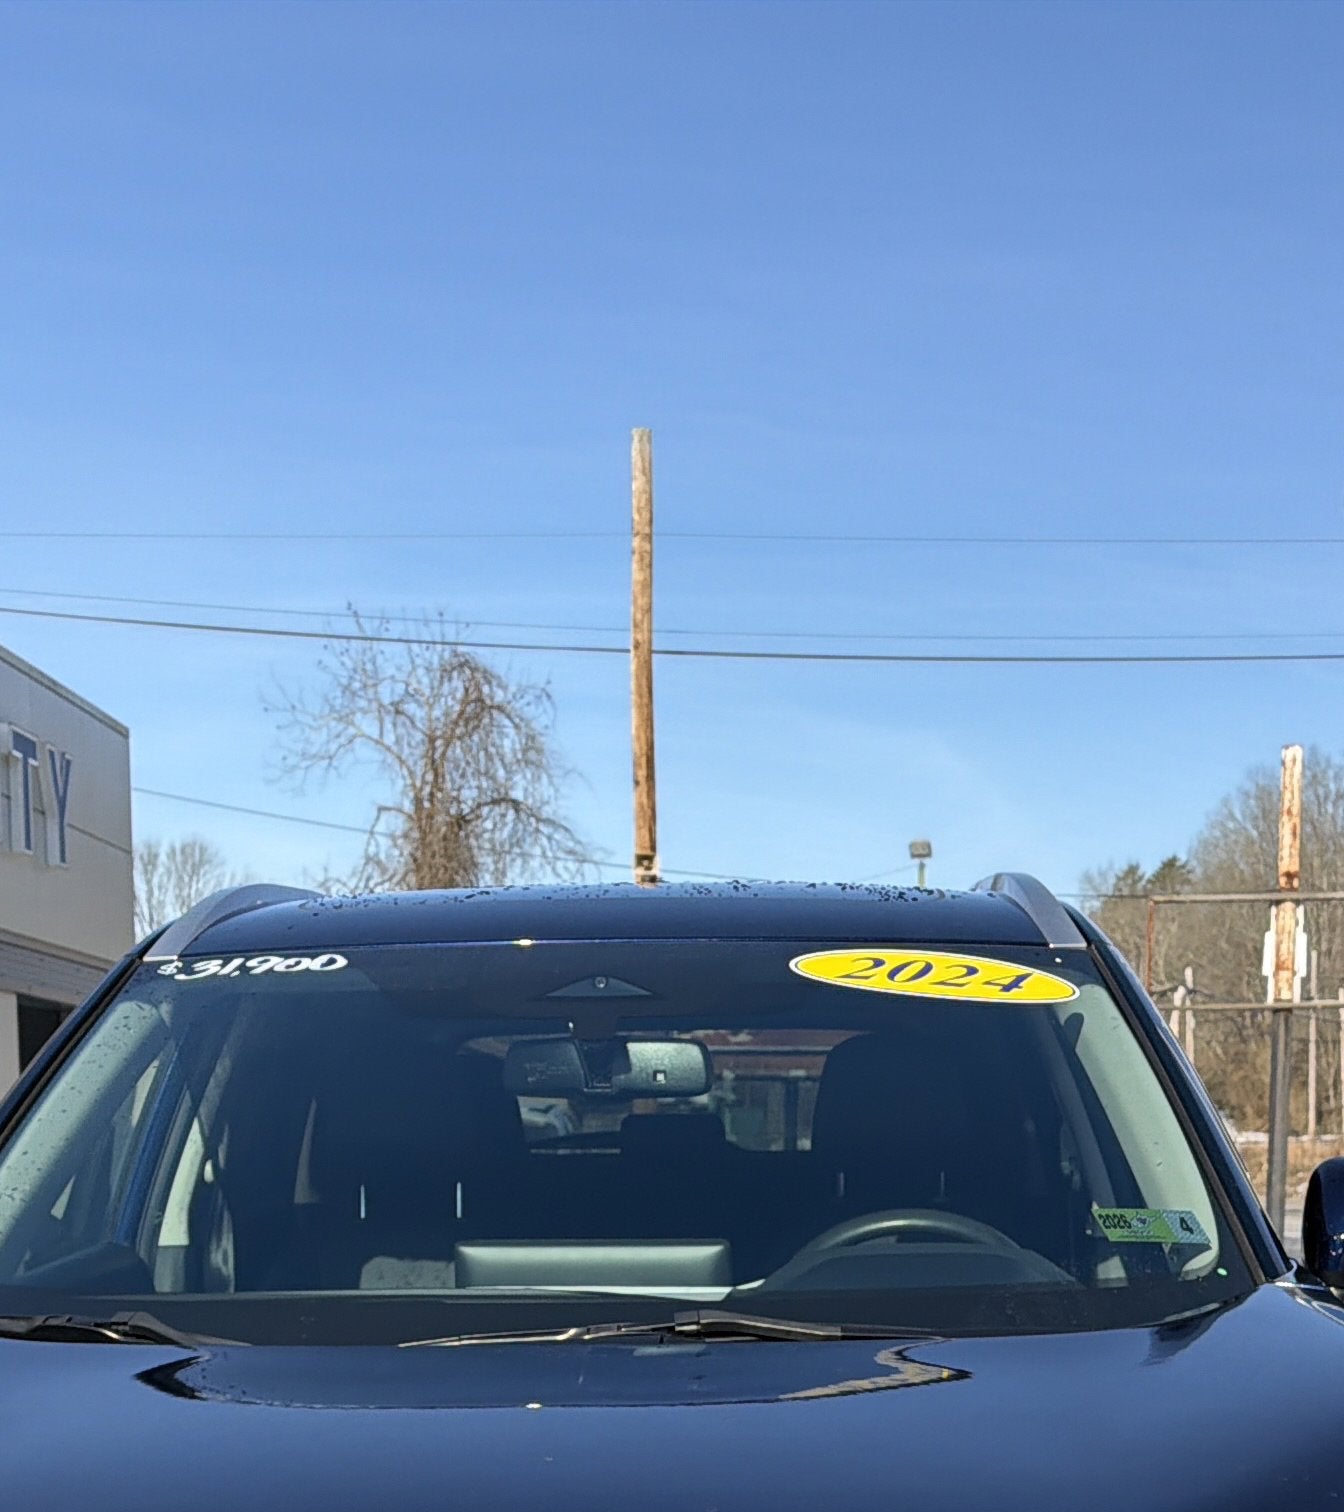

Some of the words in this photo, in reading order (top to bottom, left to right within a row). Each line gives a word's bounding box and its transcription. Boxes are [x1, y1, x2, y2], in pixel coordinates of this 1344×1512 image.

[157, 953, 348, 980] $31,900
[834, 957, 1034, 993] 2024
[1098, 1213, 1132, 1230] 2026
